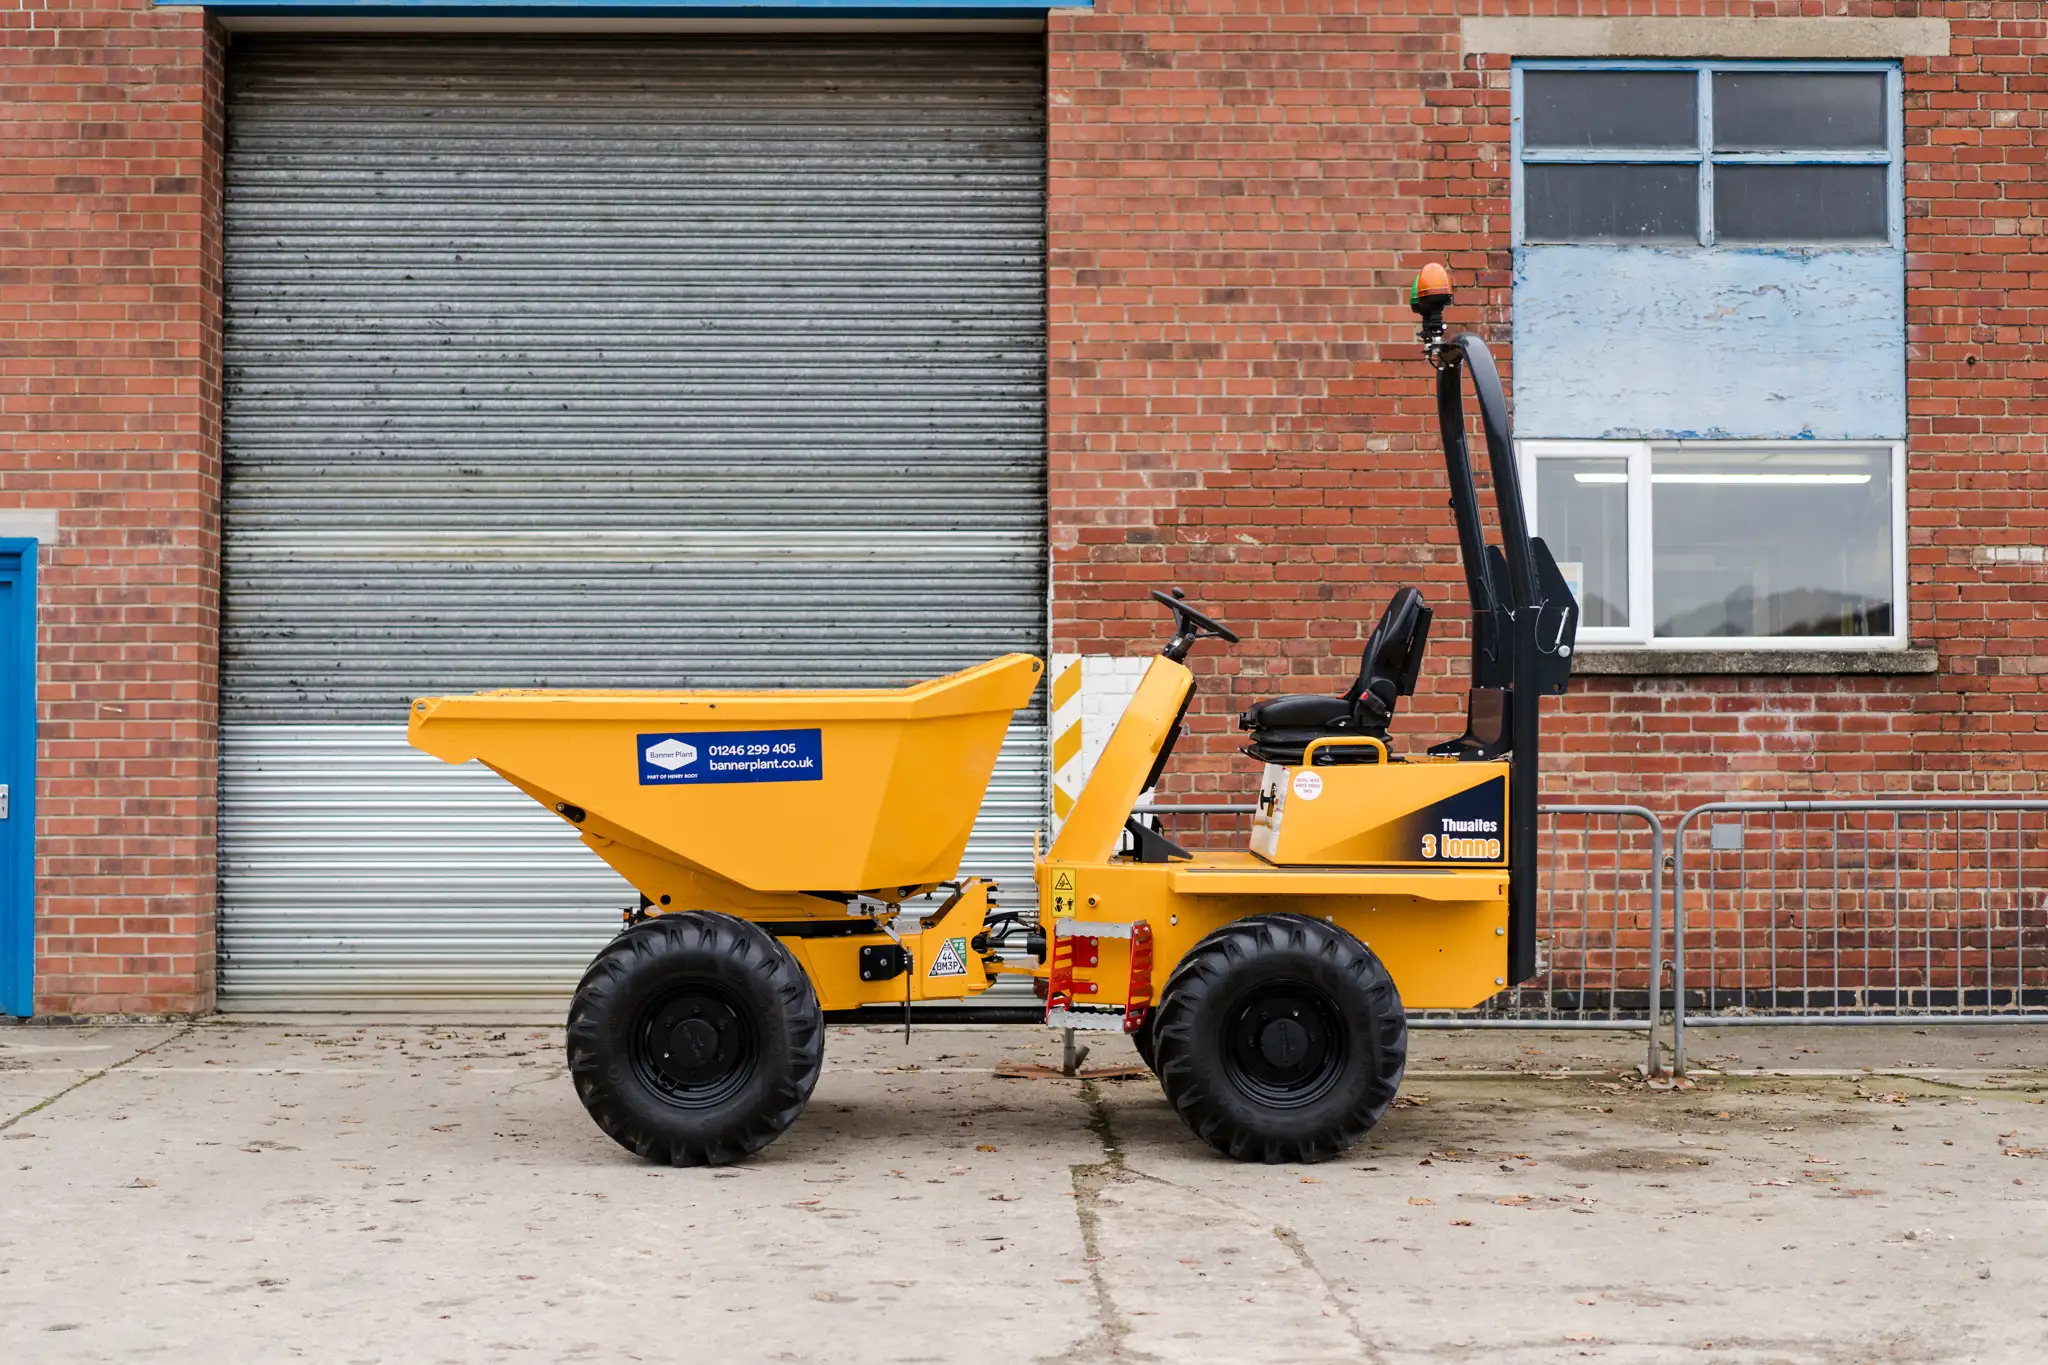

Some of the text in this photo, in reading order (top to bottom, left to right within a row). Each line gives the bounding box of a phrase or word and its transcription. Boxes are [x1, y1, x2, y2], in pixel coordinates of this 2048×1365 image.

[650, 750, 694, 759] Banner Plant
[709, 743, 796, 756] 01246 299 405
[709, 756, 813, 772] bannerplant.co.uk
[1441, 818, 1498, 832] Thwaites
[1421, 833, 1501, 859] 3 tonne
